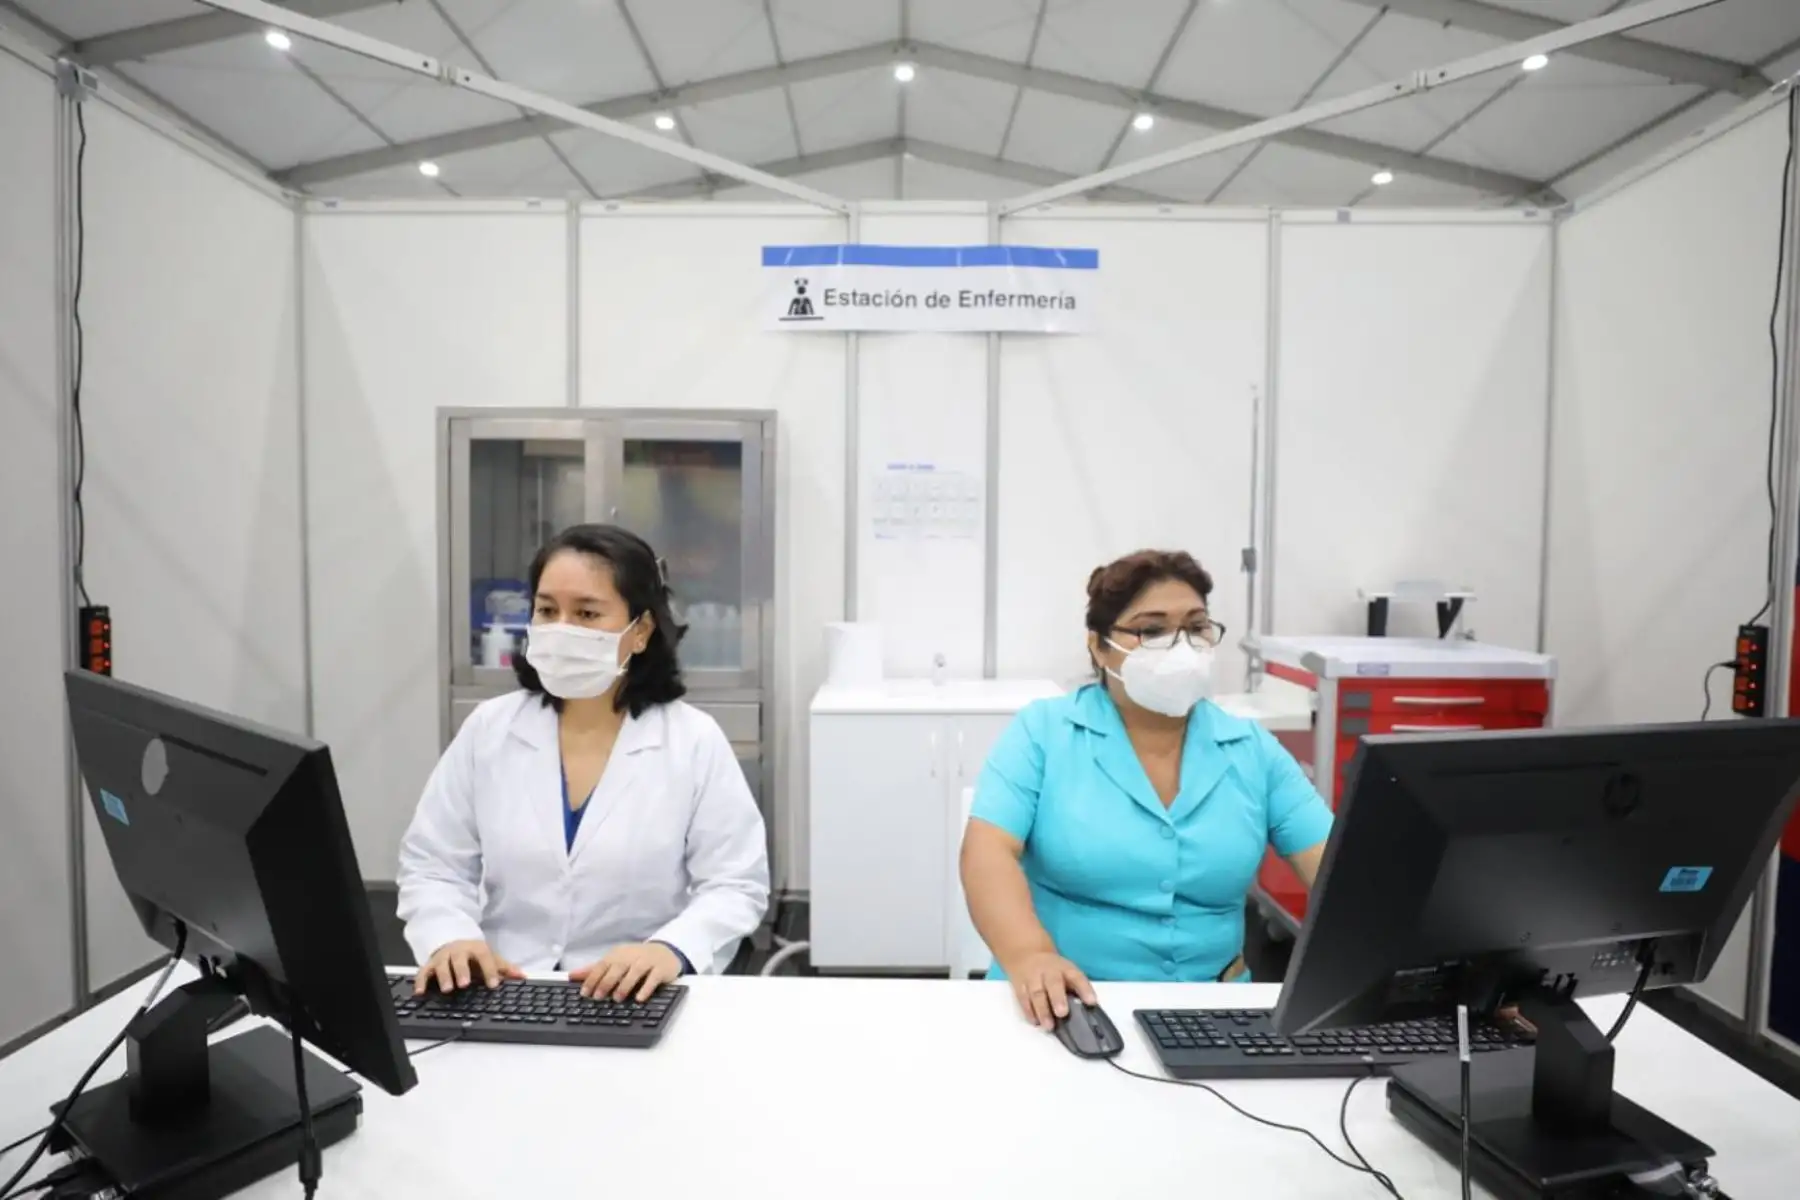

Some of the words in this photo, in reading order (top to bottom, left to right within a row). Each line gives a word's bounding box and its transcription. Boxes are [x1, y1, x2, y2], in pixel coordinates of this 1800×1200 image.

[823, 287, 918, 308] Estación
[924, 290, 951, 309] de
[958, 289, 1076, 310] Enfermería
